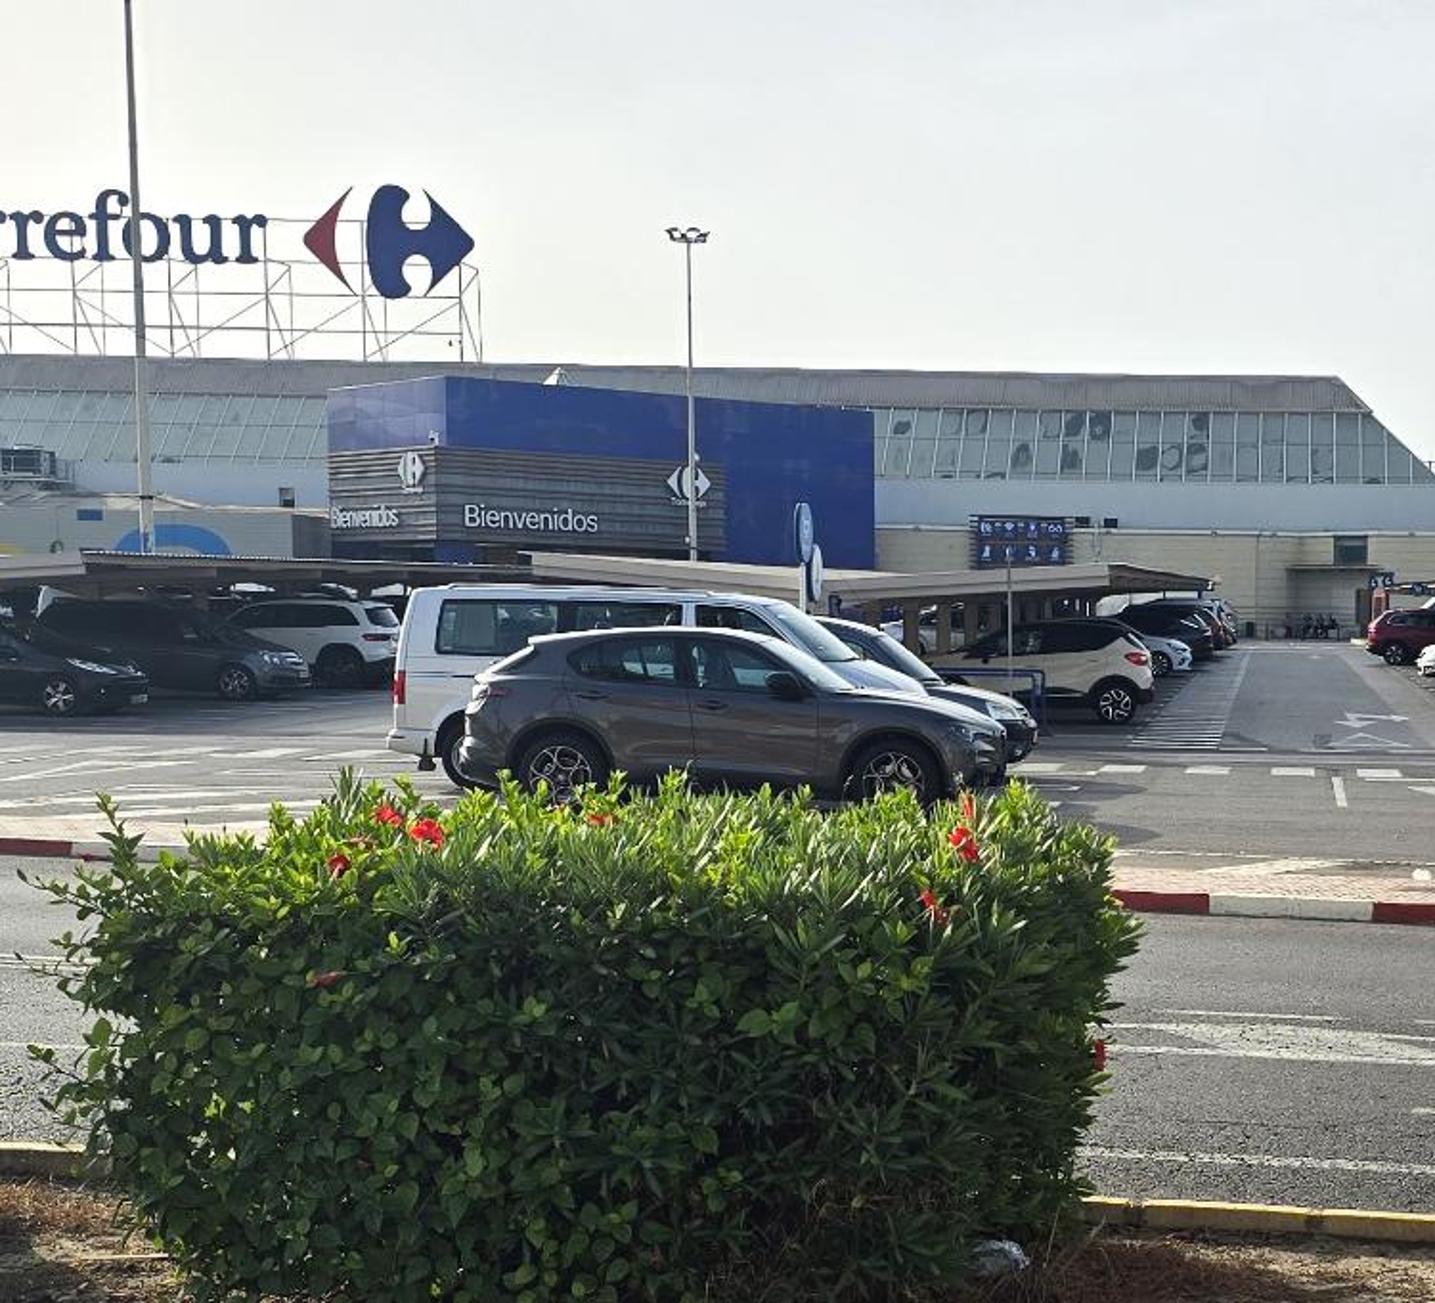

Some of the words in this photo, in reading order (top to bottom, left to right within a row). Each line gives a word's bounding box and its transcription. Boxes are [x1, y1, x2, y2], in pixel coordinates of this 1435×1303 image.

[0, 190, 268, 265] refour
[329, 505, 399, 529] Bienvenidos
[463, 503, 599, 533] Bienvenidos
